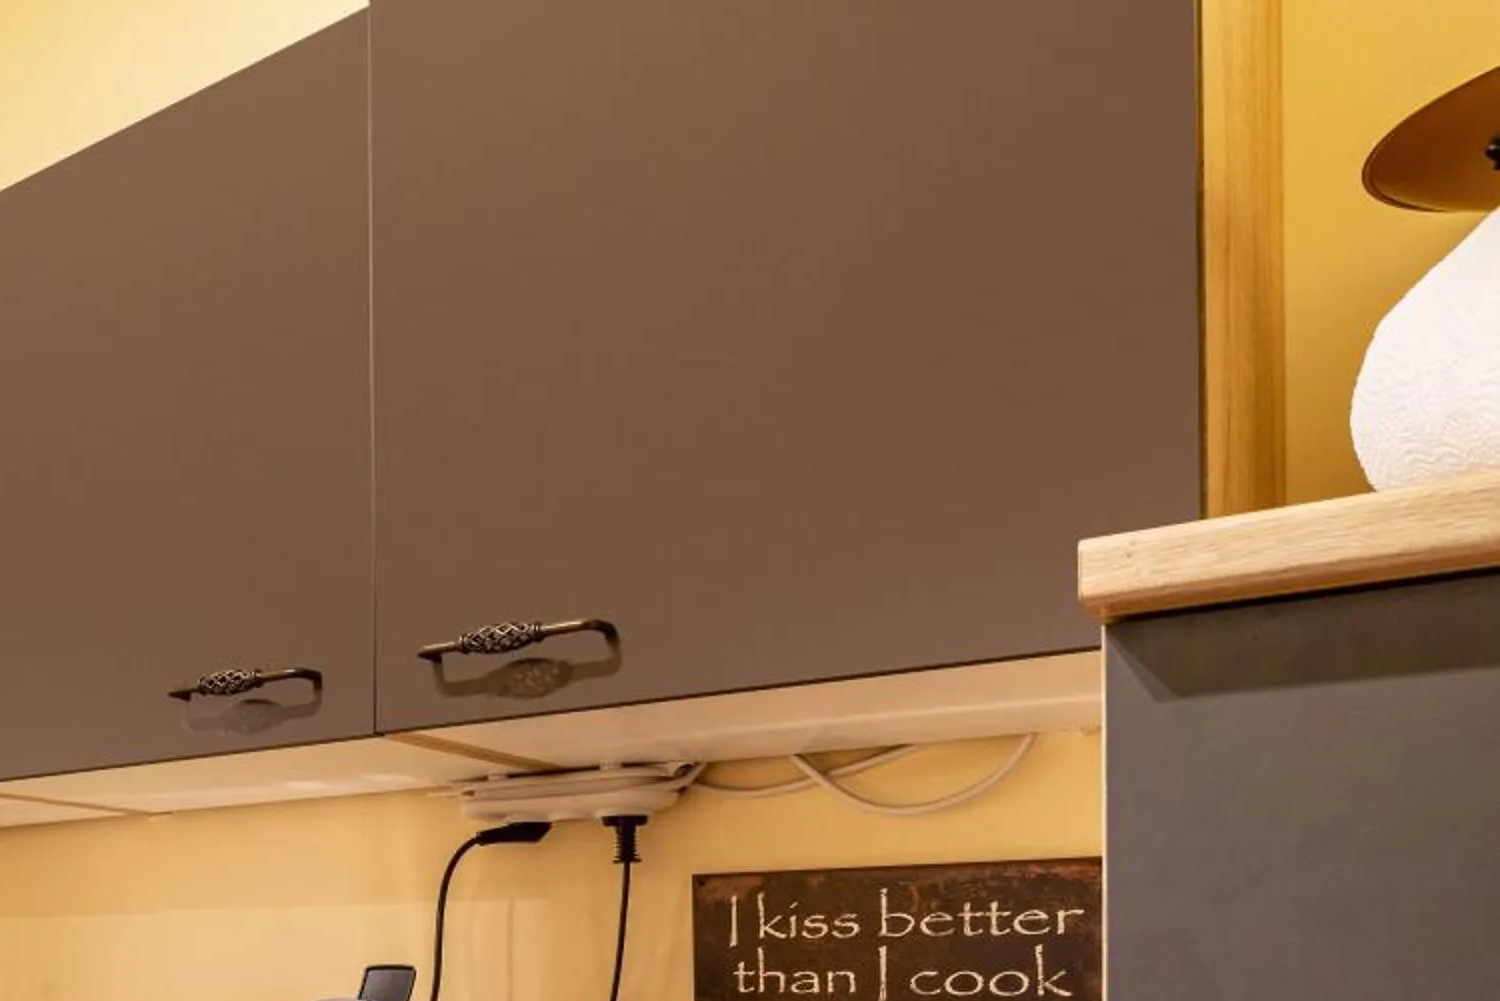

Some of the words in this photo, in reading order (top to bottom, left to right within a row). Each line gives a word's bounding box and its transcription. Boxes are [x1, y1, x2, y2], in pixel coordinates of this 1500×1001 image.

[729, 894, 738, 947] I
[757, 892, 861, 940] kiss
[878, 887, 1086, 938] better
[733, 946, 857, 994] than
[909, 944, 1073, 998] cook
